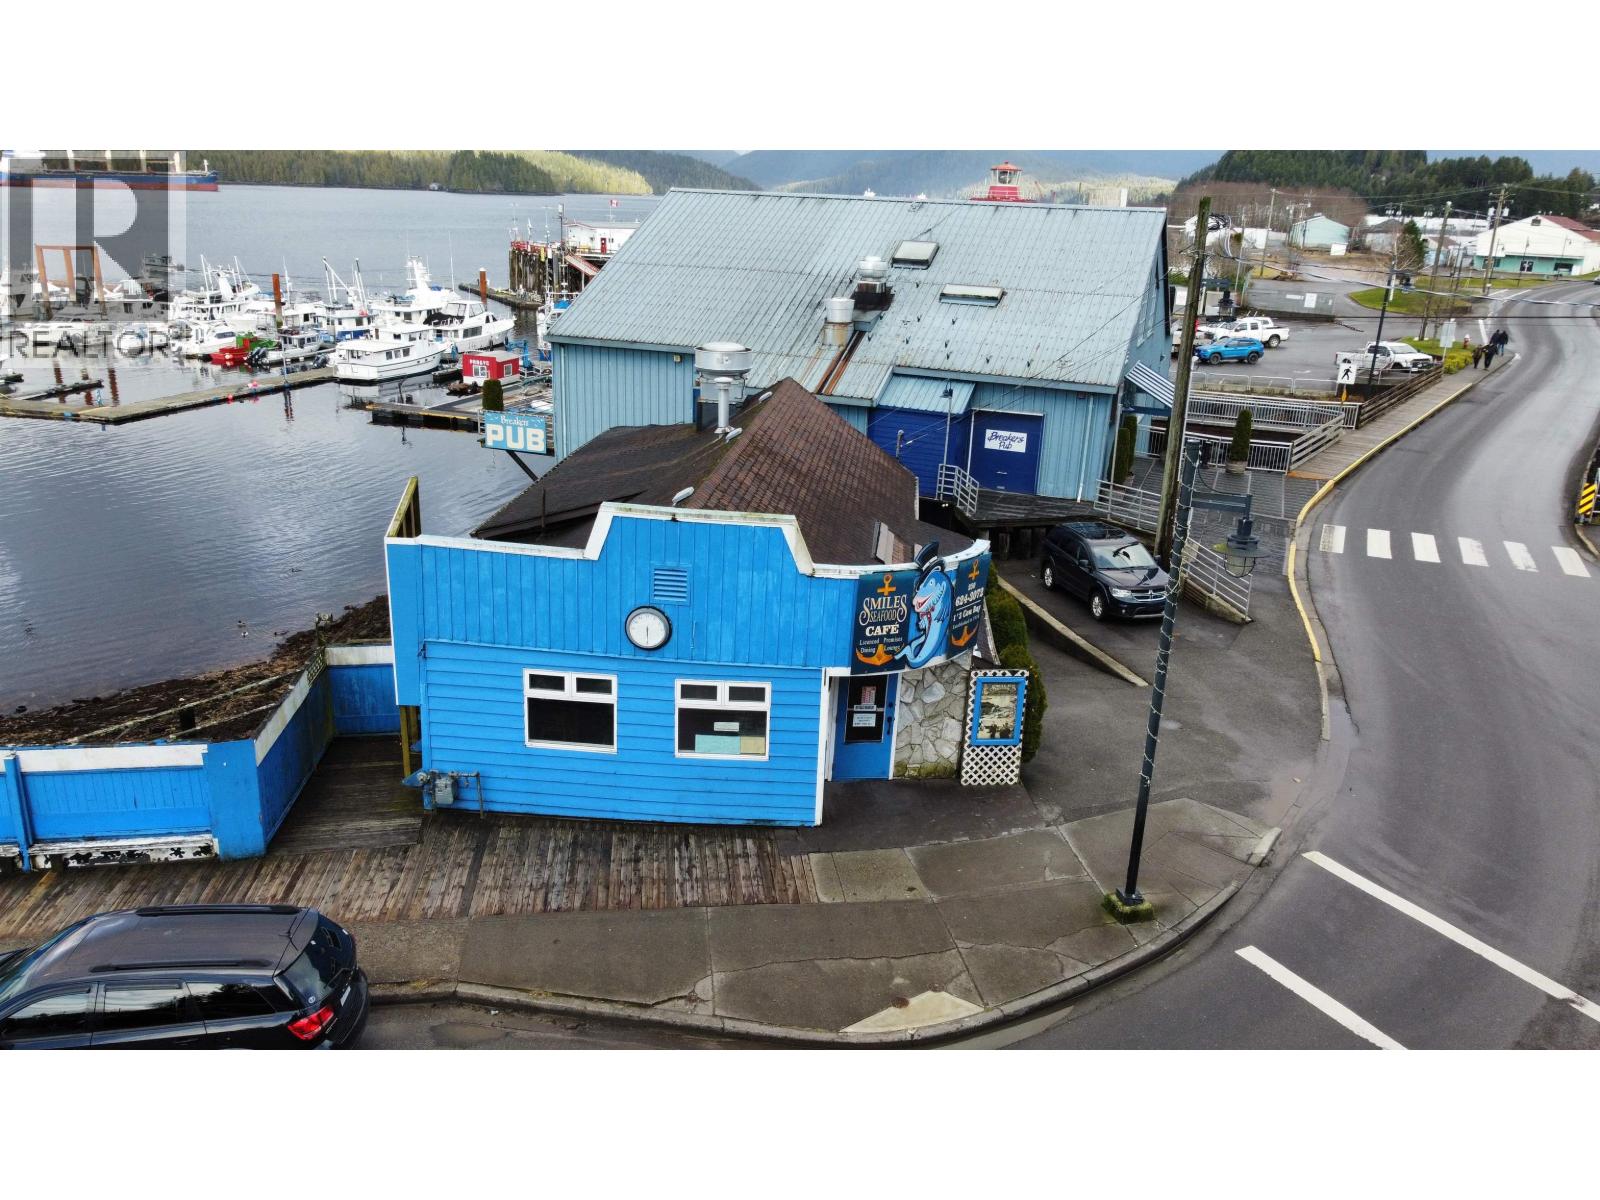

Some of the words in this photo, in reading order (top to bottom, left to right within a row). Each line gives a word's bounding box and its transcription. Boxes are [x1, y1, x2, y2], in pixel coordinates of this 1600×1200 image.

[486, 424, 545, 452] PUB
[988, 432, 1024, 443] Breakers
[999, 441, 1013, 449] Pub
[859, 594, 908, 626] SMILES
[869, 609, 897, 623] SEAFOOD
[865, 622, 899, 637] CAFÉ
